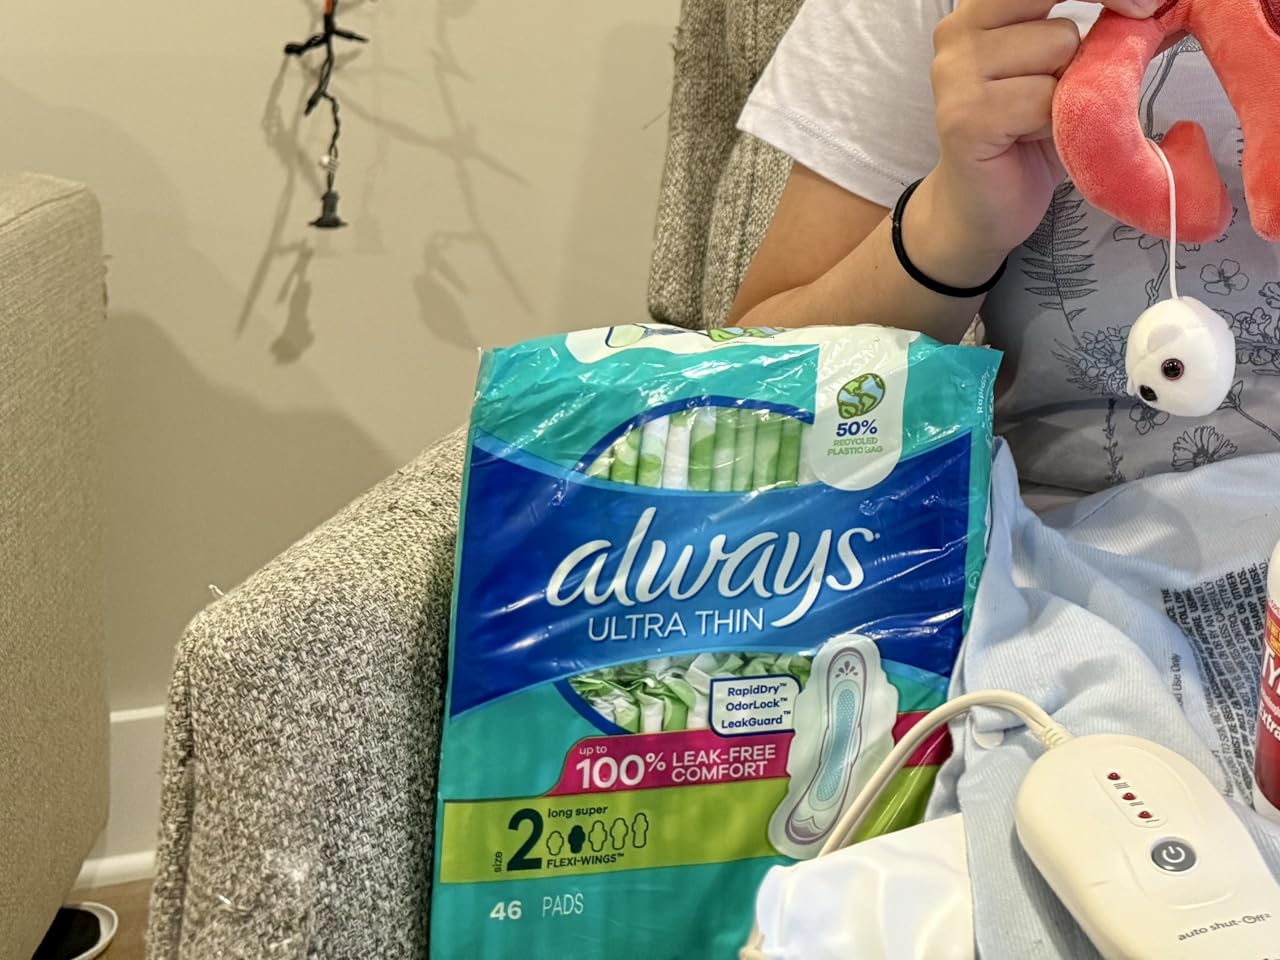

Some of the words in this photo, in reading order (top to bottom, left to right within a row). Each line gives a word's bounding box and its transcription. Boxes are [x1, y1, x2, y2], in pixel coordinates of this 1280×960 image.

[835, 419, 879, 437] 50%
[544, 506, 876, 629] always
[1225, 571, 1242, 600] OTHER
[588, 611, 687, 642] ULTRA
[695, 607, 765, 634] THIN
[1248, 601, 1263, 630] SHARP
[579, 746, 592, 756] up
[594, 745, 608, 754] to
[672, 744, 776, 766] LEAK-FREE
[576, 752, 666, 789] 100%
[672, 762, 768, 782] COMFORT
[548, 807, 572, 818] long
[576, 806, 608, 818] super
[494, 851, 503, 872] size
[506, 808, 544, 872] 2
[489, 900, 522, 921] 46
[542, 892, 584, 917] PADS
[1178, 928, 1208, 941] auto
